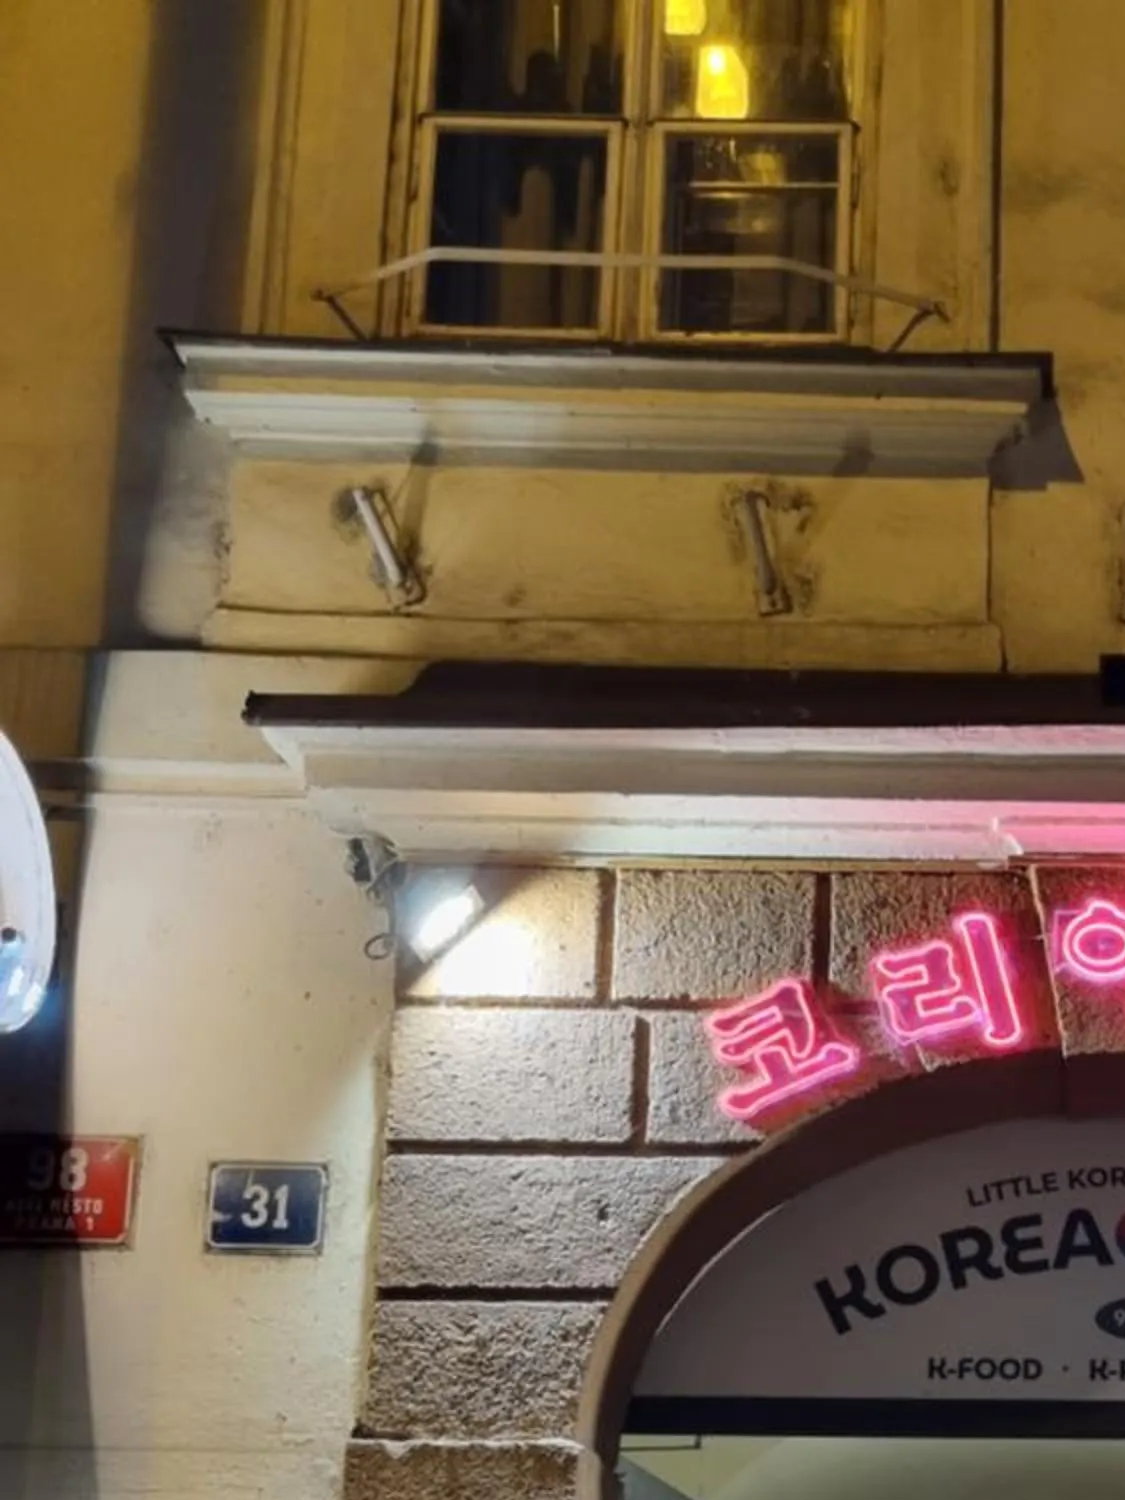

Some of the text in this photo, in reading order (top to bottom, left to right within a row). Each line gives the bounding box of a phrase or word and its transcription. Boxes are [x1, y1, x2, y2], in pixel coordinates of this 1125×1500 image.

[240, 1184, 289, 1229] 31
[966, 1170, 1060, 1208] LITTLE
[813, 1208, 1114, 1335] KOREA
[927, 1356, 1043, 1382] K-FOOD
